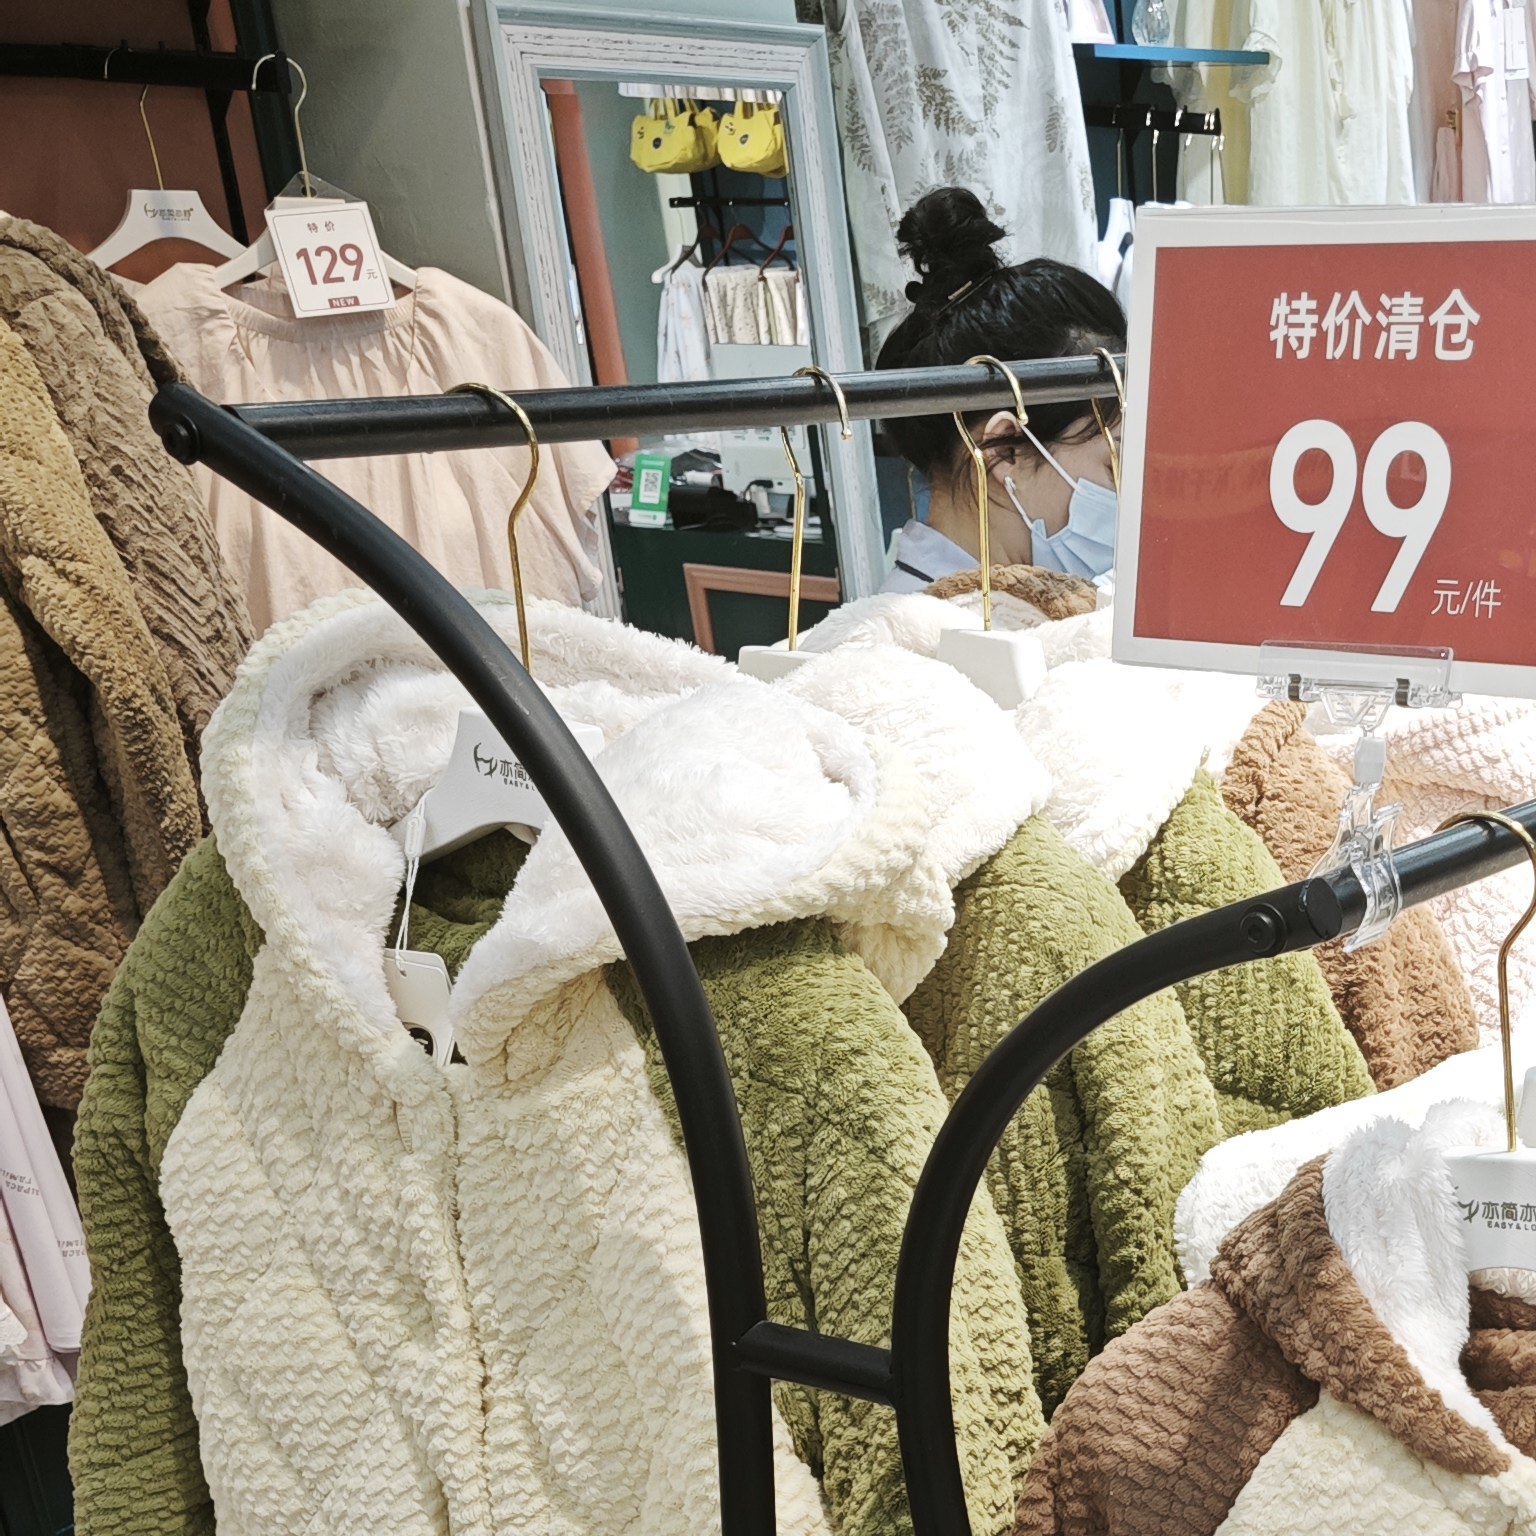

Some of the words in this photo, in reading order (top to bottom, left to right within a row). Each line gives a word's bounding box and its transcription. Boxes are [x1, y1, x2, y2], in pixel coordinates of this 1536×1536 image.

[307, 221, 335, 234] 特价
[295, 243, 364, 286] 129
[366, 268, 378, 280] 元
[332, 296, 357, 307] NEW
[1268, 288, 1480, 362] 特价清仓
[1269, 419, 1452, 613] 99
[1431, 579, 1502, 619] 元/件
